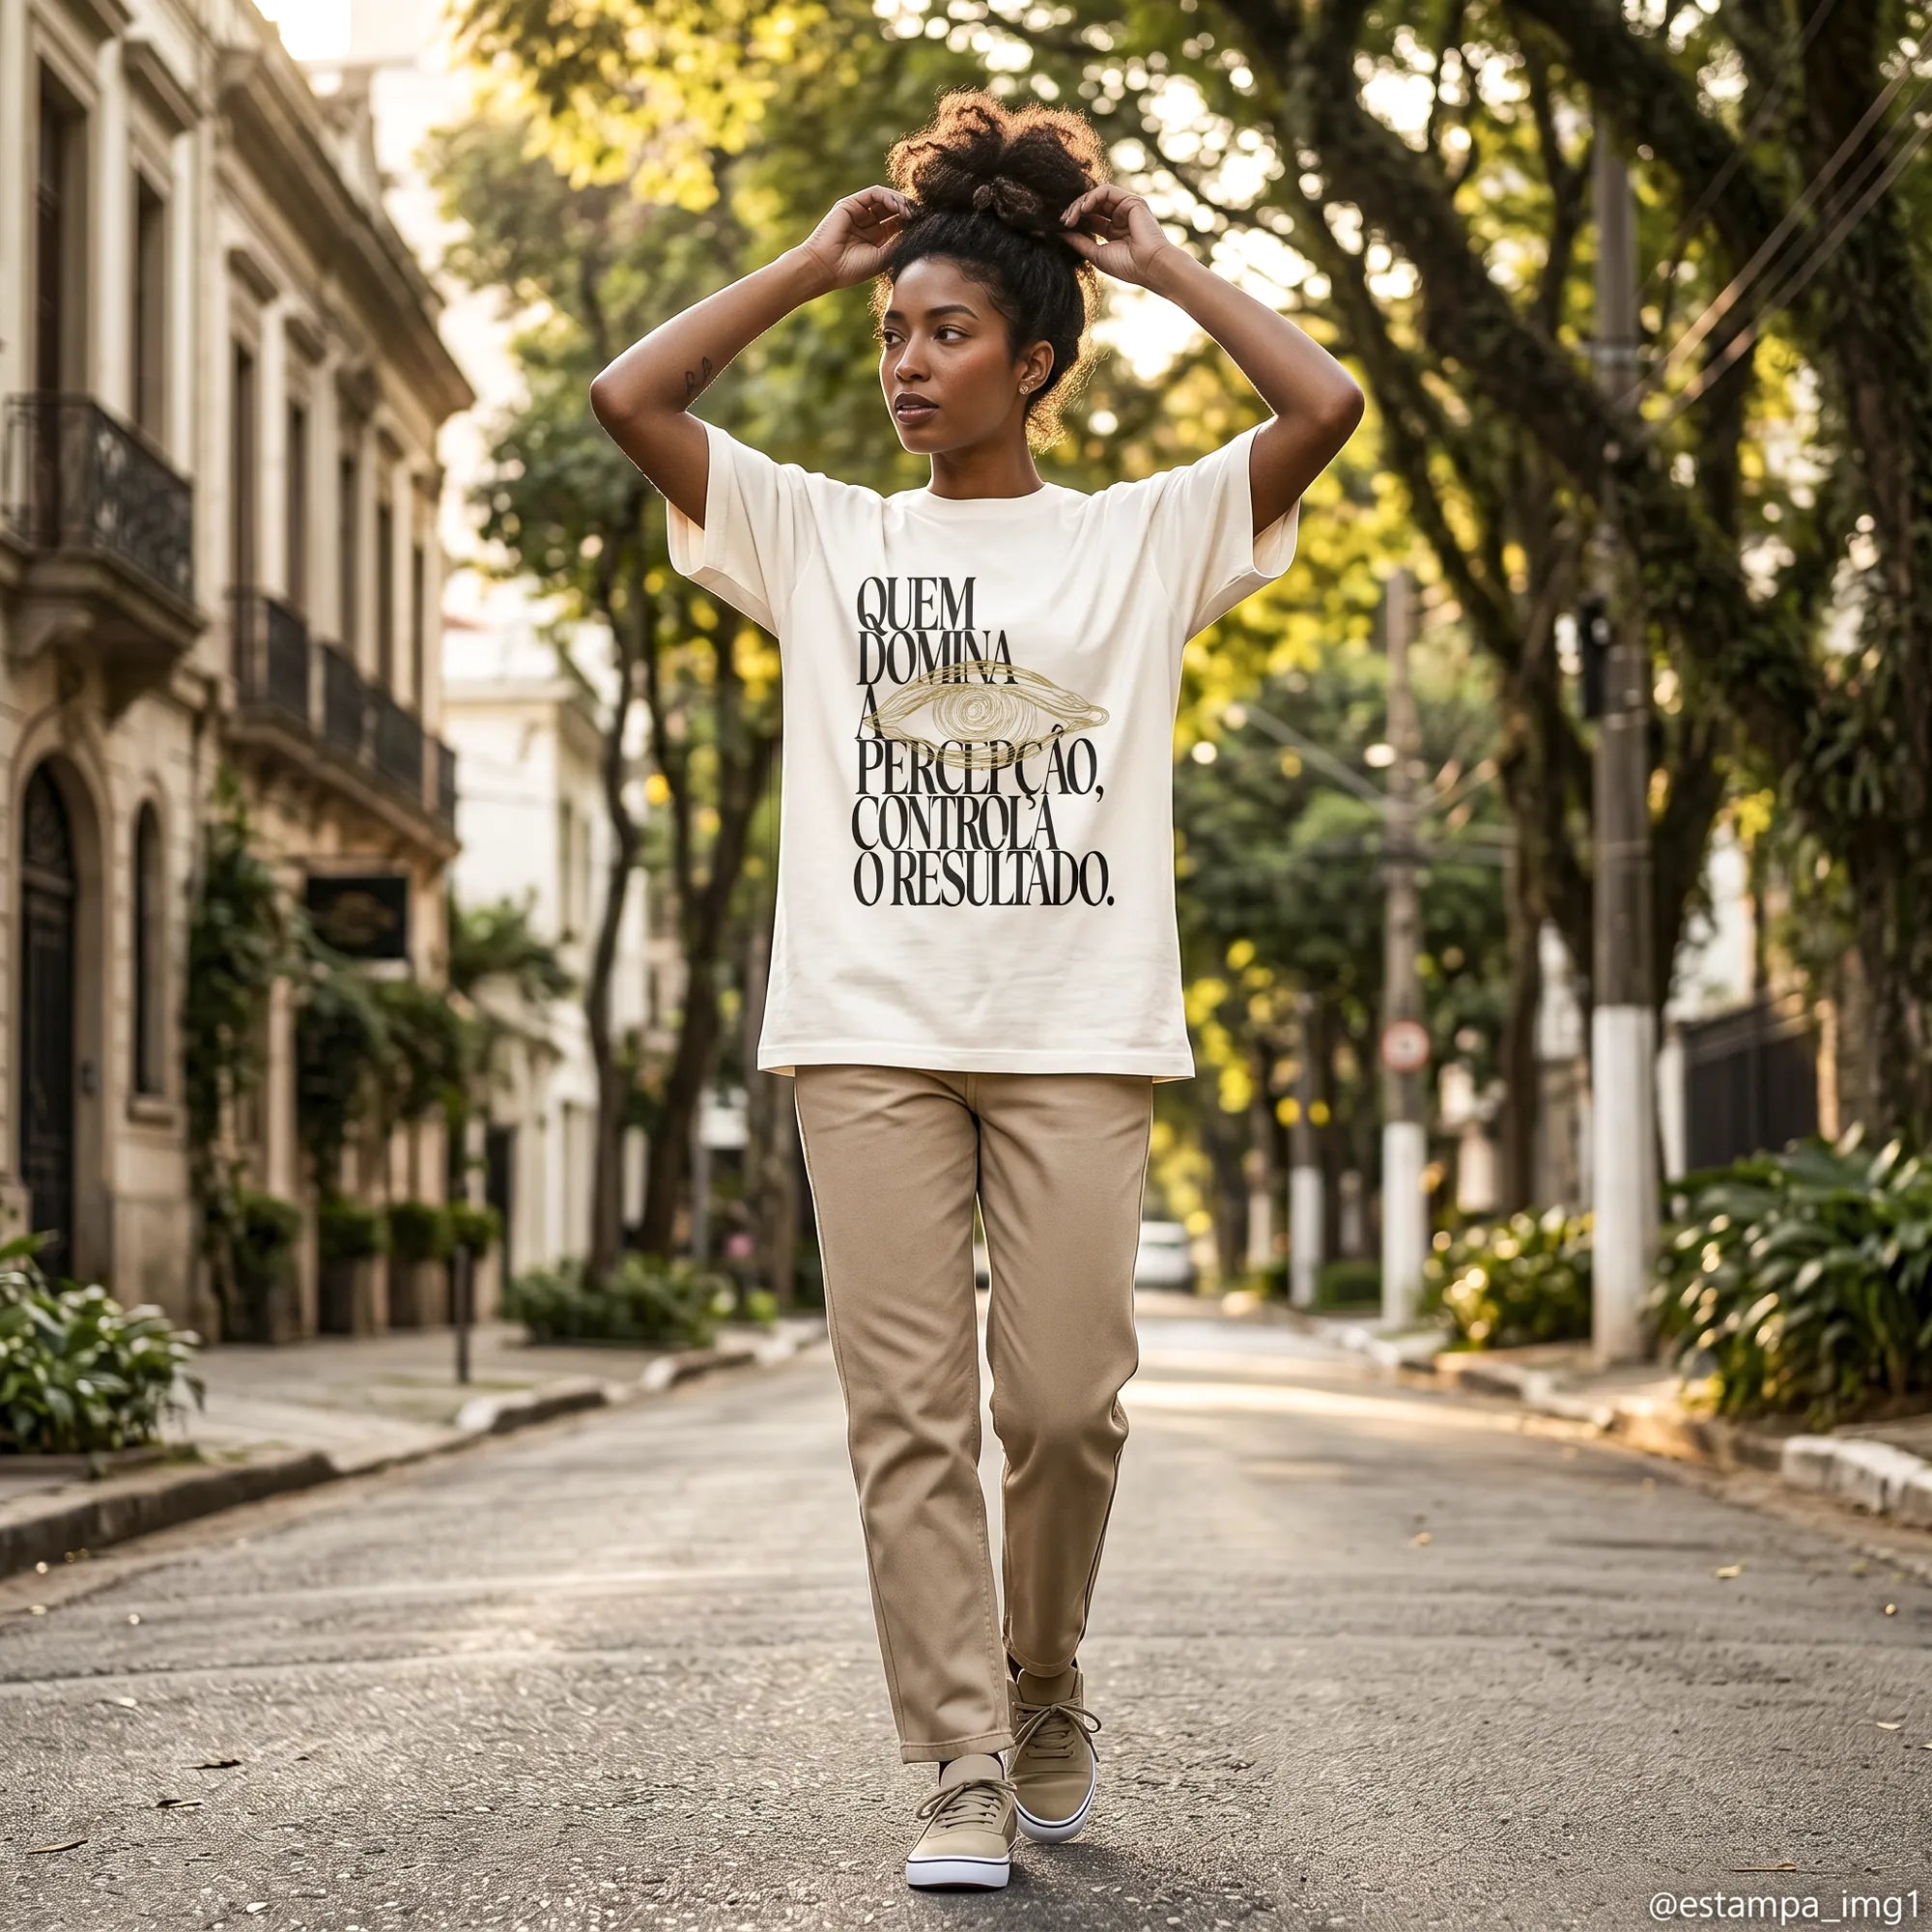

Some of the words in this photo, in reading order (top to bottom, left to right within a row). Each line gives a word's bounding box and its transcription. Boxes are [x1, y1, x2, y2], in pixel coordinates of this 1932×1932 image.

[857, 577, 977, 636] QUEM
[856, 630, 1019, 685] DOMINA
[856, 683, 883, 740] A
[851, 795, 1060, 850] CONTROLA
[853, 850, 884, 906] O
[890, 850, 1115, 906] RESULTADO.
